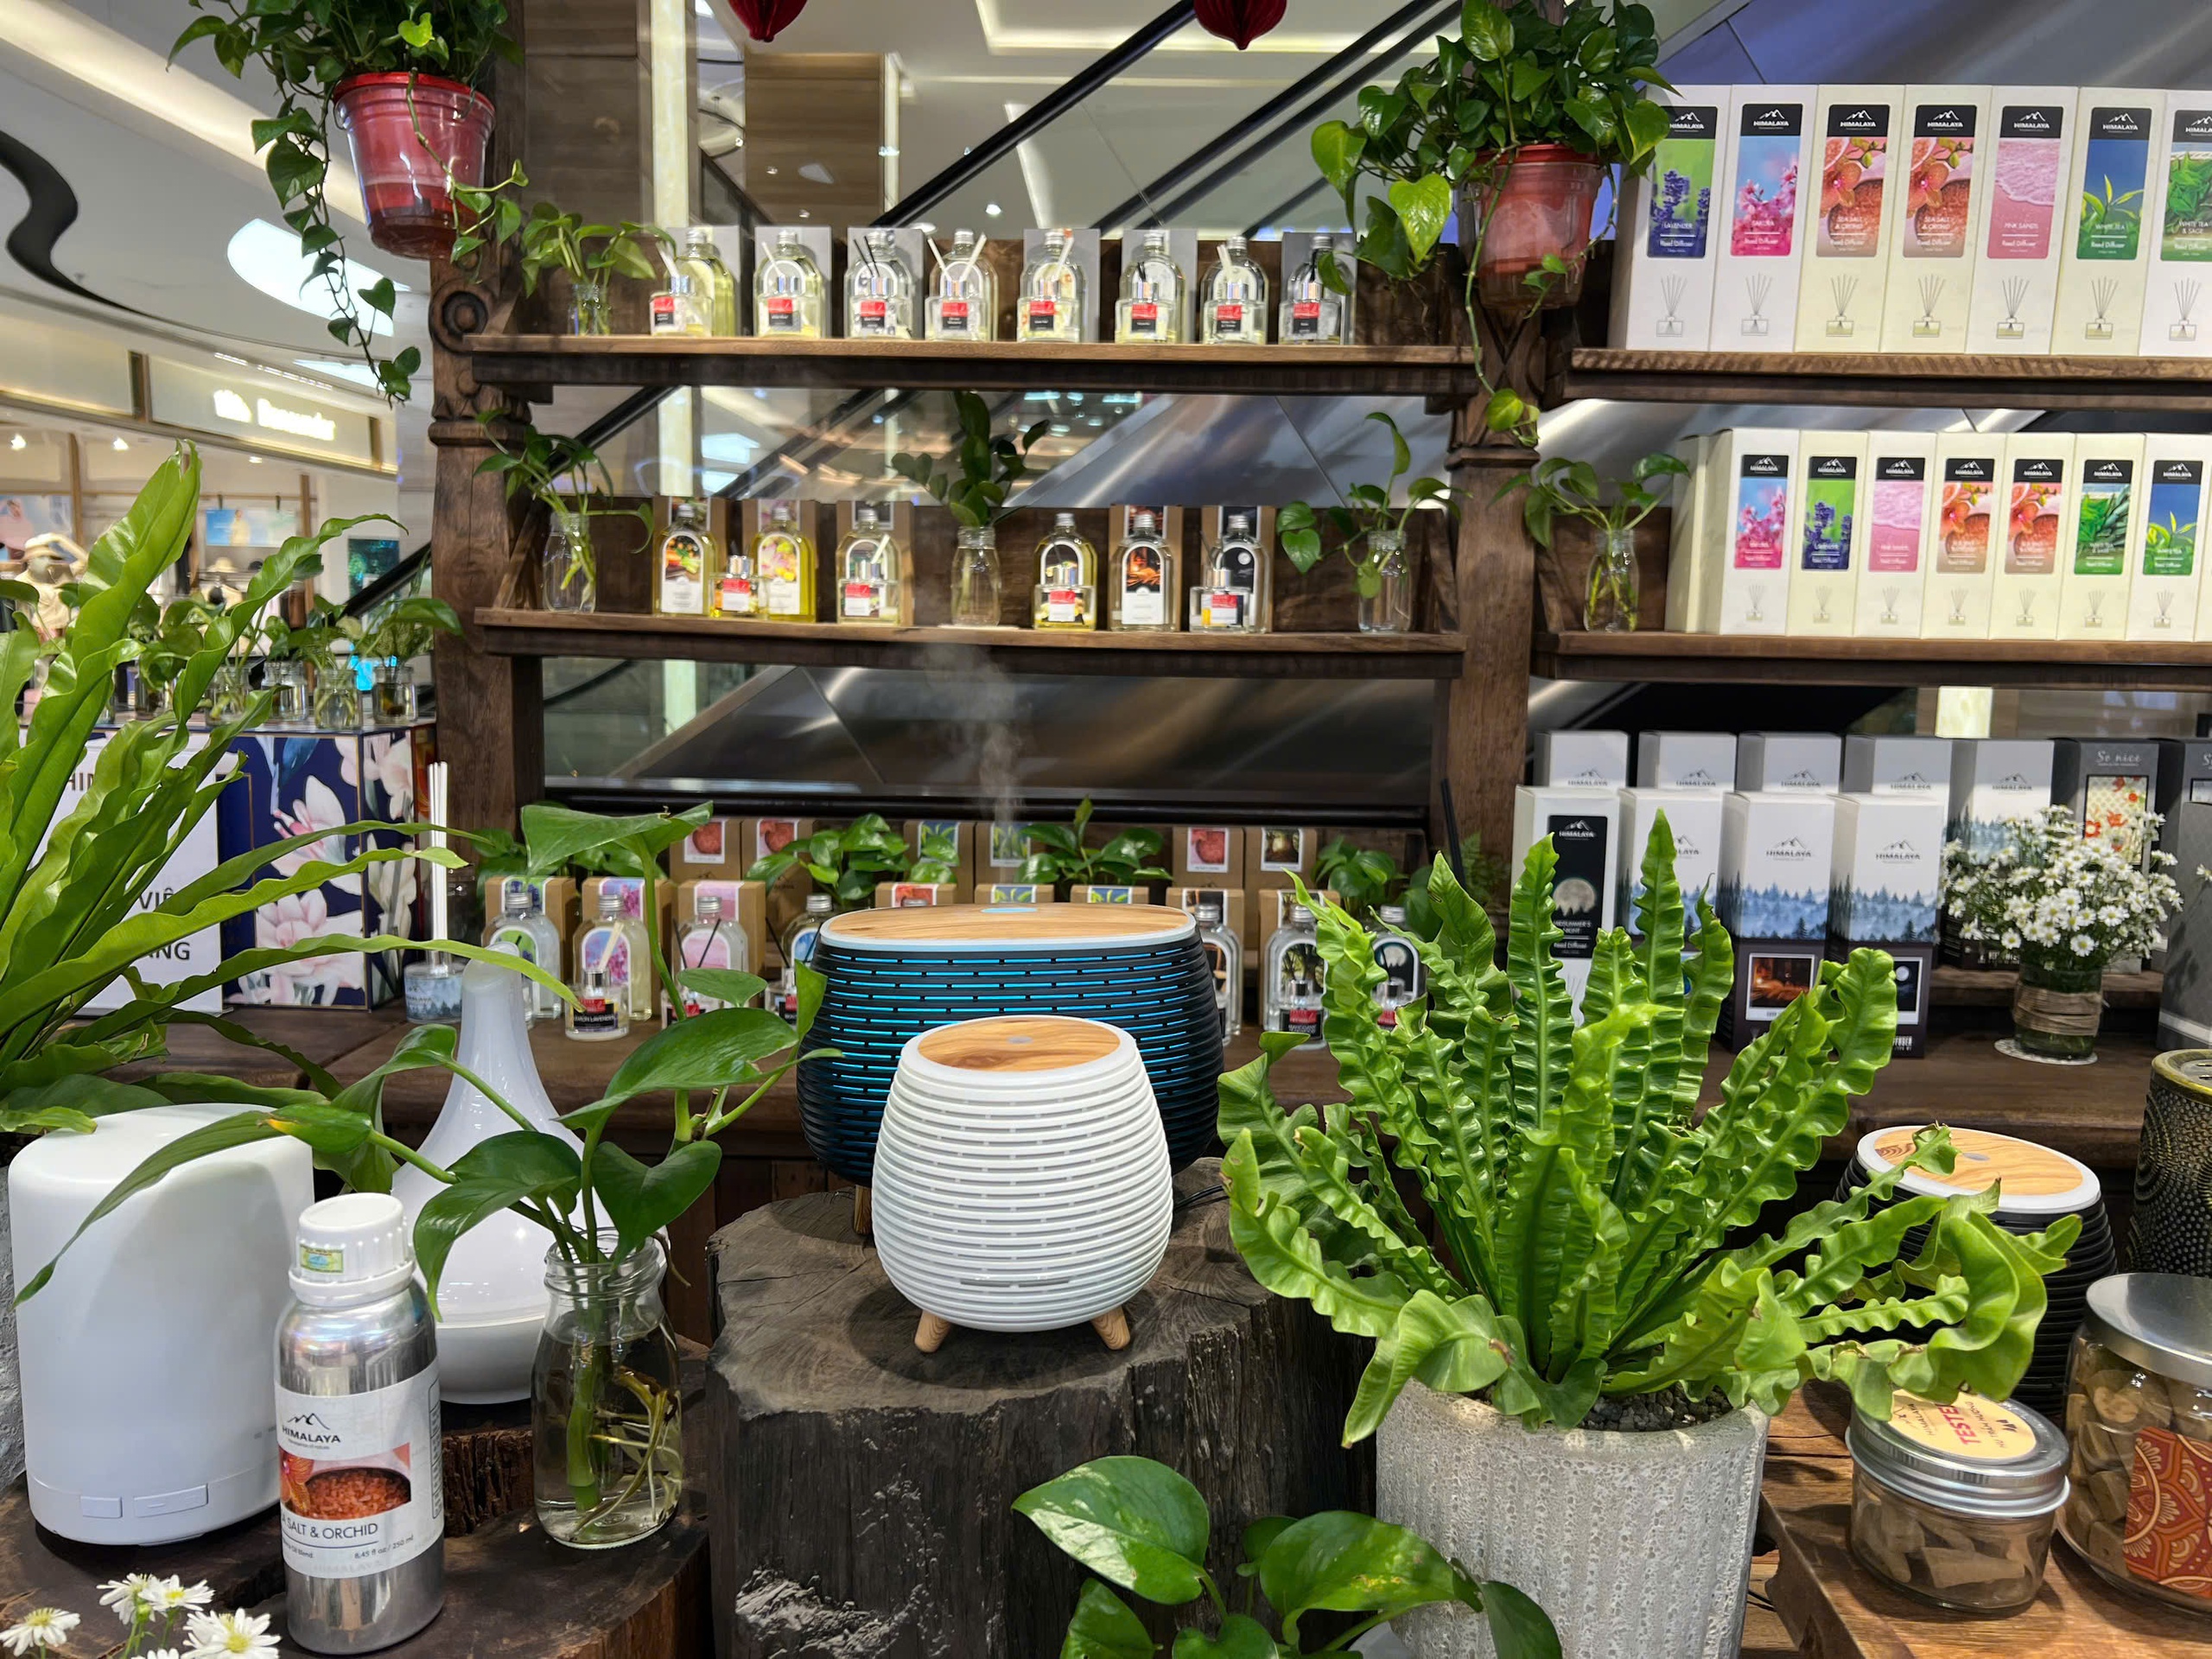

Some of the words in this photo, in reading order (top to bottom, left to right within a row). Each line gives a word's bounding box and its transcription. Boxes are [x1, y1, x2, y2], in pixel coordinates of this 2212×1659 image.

[1907, 1403, 1936, 1436] HIMALAYA
[1935, 1403, 1981, 1446] TESTE
[282, 1425, 341, 1444] HIMALAYA
[287, 1517, 307, 1535] SALT
[310, 1526, 319, 1538] &
[322, 1522, 378, 1540] ORCHID
[354, 1550, 370, 1559] 8.45
[392, 1539, 404, 1549] 250
[405, 1534, 414, 1544] ml
